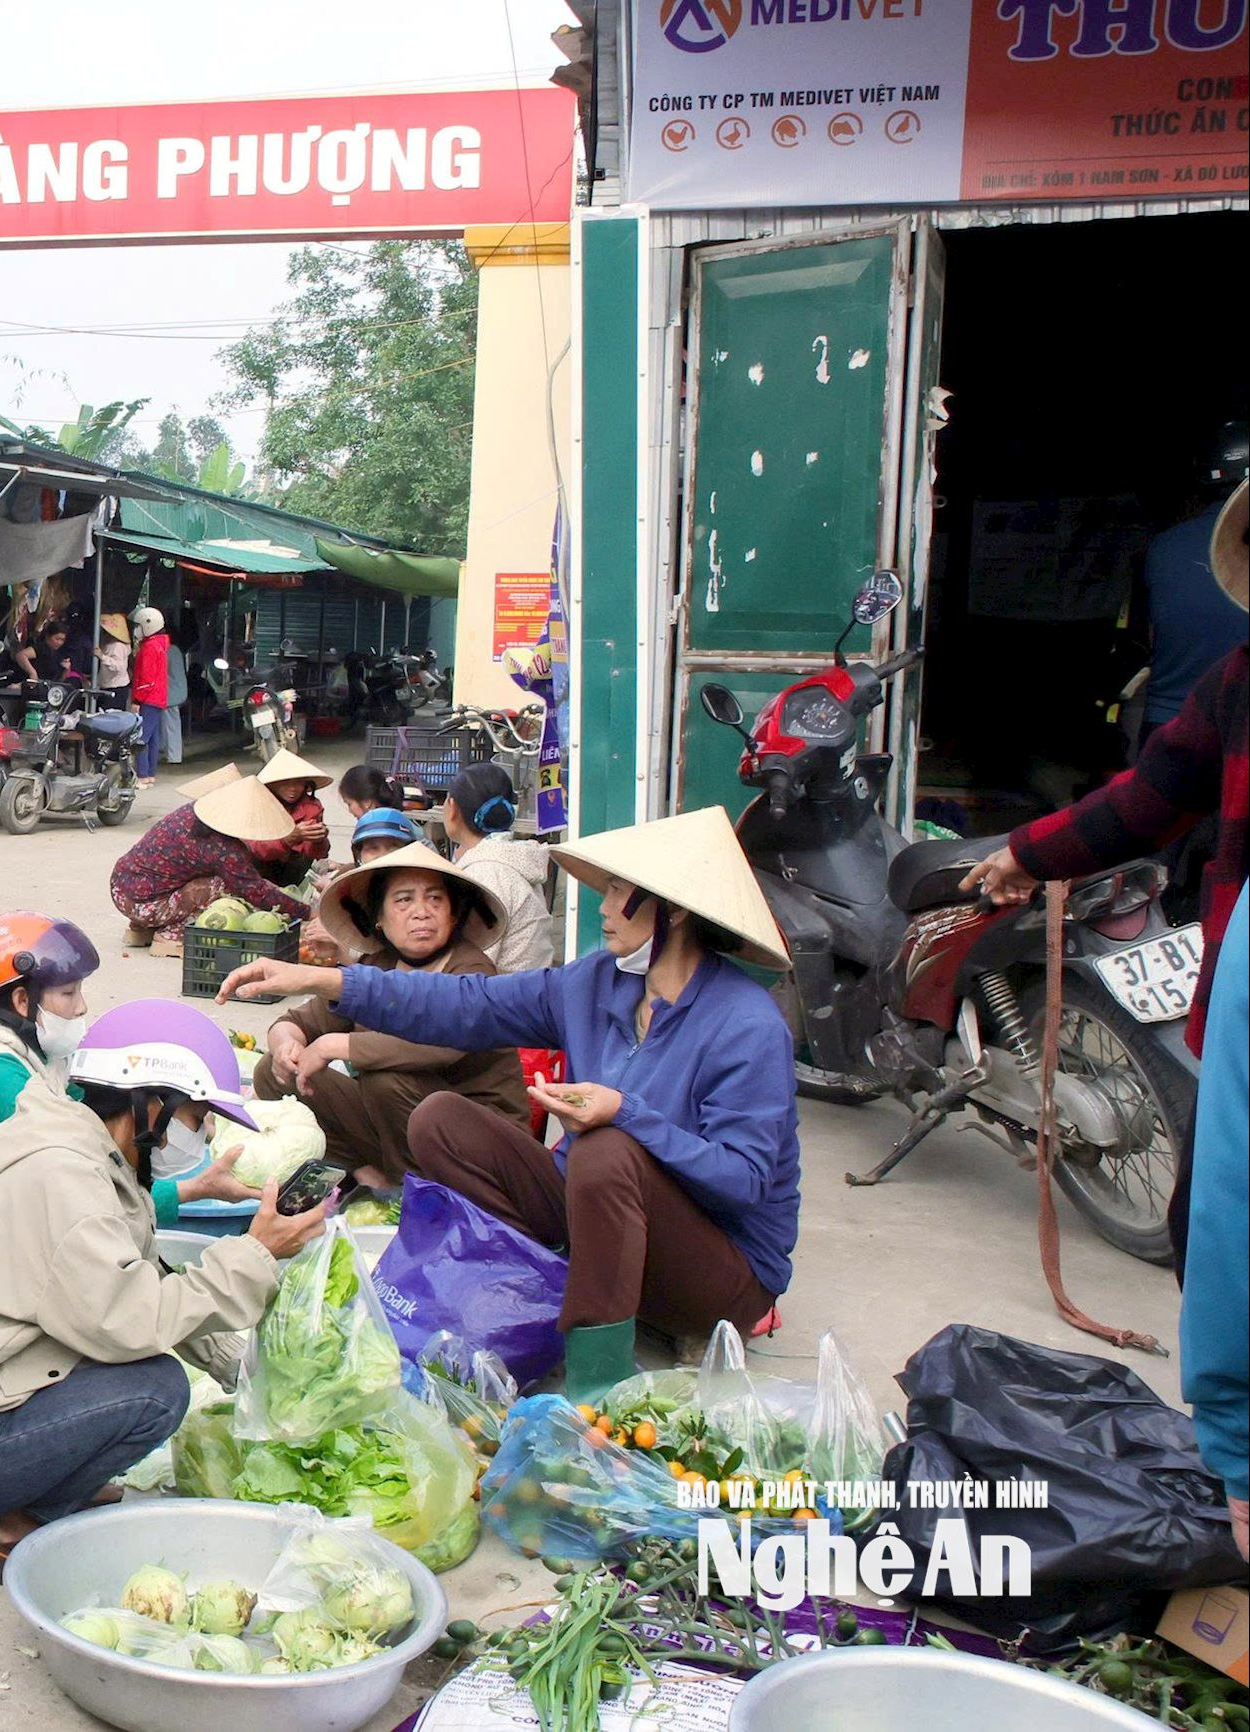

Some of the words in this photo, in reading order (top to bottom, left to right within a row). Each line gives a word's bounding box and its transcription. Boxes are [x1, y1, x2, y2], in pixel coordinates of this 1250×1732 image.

[750, 0, 922, 26] MEDIVET
[650, 93, 692, 112] CÔNG
[699, 95, 717, 110] TY
[722, 94, 744, 109] CP
[750, 92, 774, 108] TM
[780, 89, 853, 107] MEDIVET
[859, 83, 896, 107] VIỆT
[901, 85, 940, 102] NAM
[1111, 107, 1182, 137] THỨC
[1190, 105, 1226, 133] ĂN
[157, 122, 481, 206] PHƯỢNG
[1042, 169, 1073, 187] XÓM
[1079, 171, 1086, 185] 1
[1091, 170, 1125, 185] NAM
[1129, 167, 1159, 183] SƠN
[144, 1057, 187, 1070] TPBank
